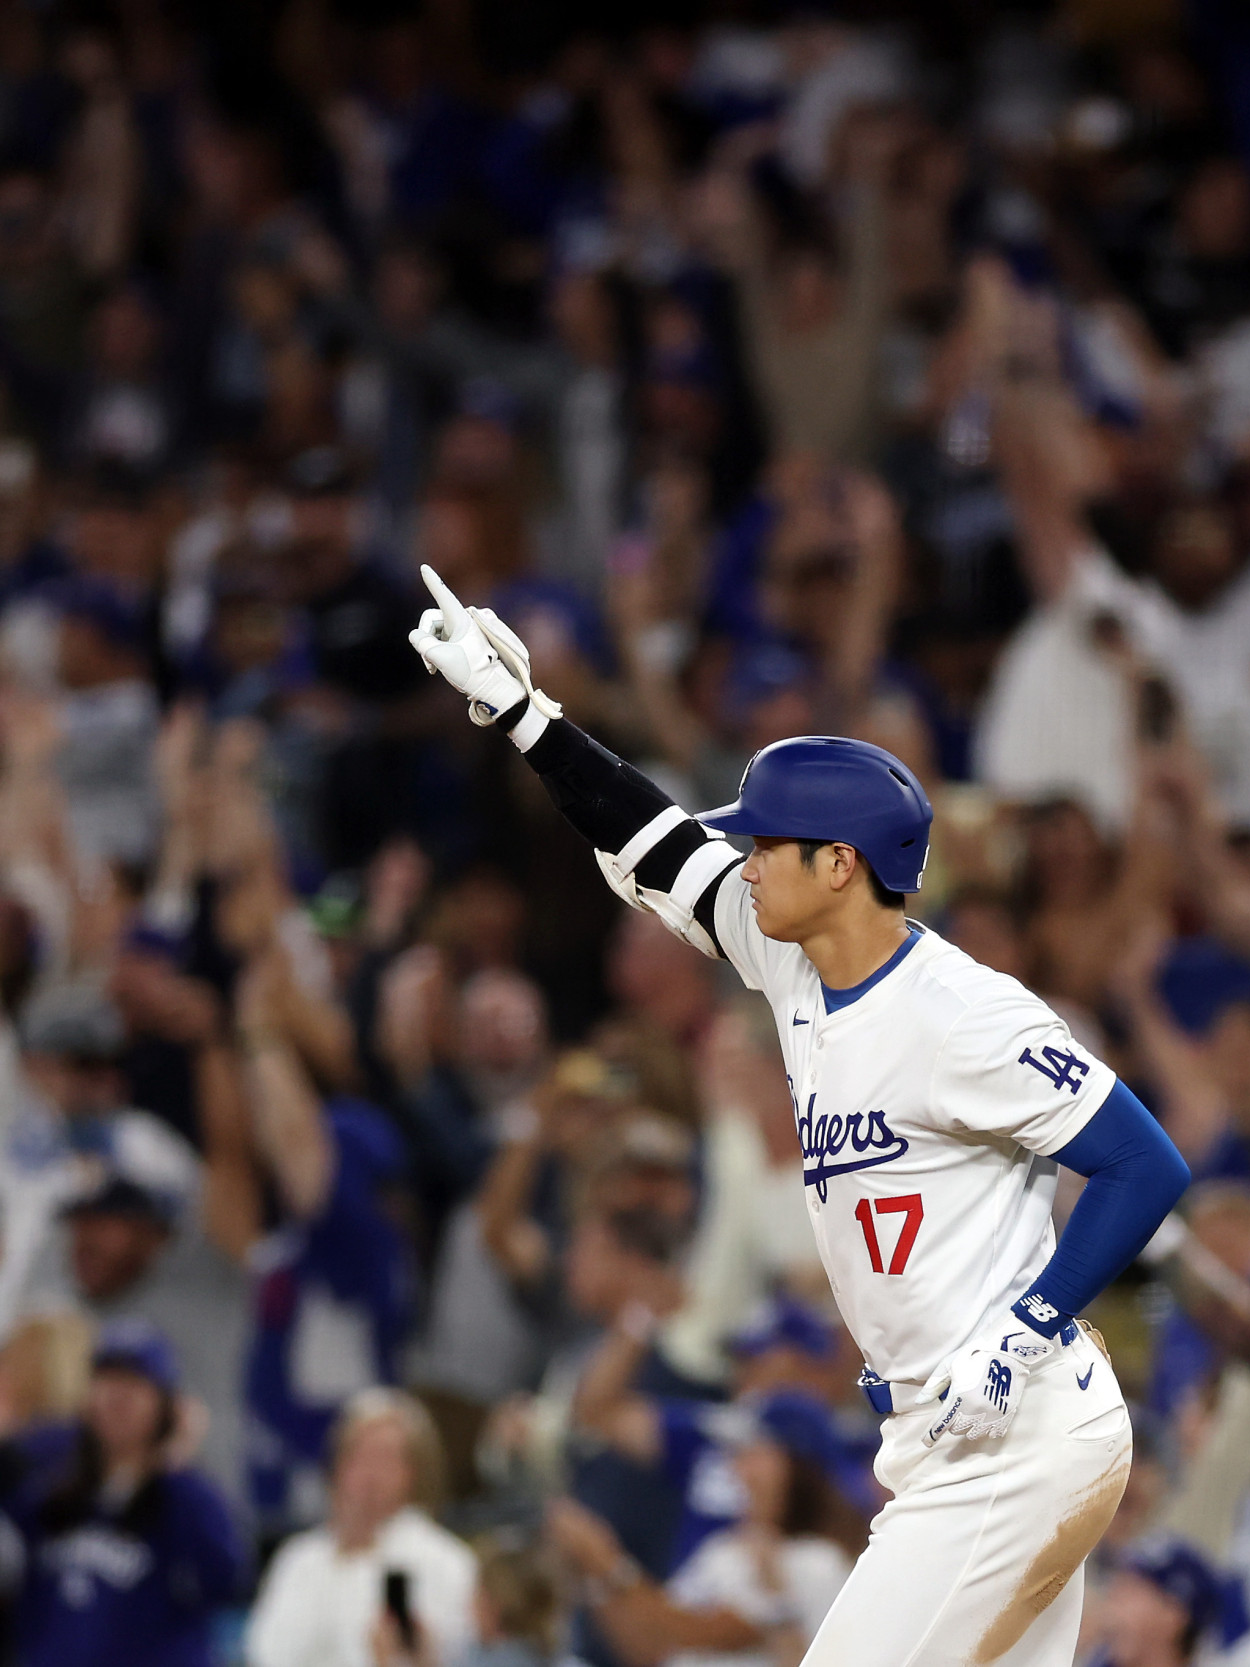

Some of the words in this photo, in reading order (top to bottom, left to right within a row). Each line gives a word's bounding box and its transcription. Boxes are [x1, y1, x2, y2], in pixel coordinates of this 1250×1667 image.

[1017, 1045, 1090, 1096] LA
[854, 1192, 925, 1276] 17
[934, 1423, 945, 1434] new
[942, 1397, 962, 1424] balance
